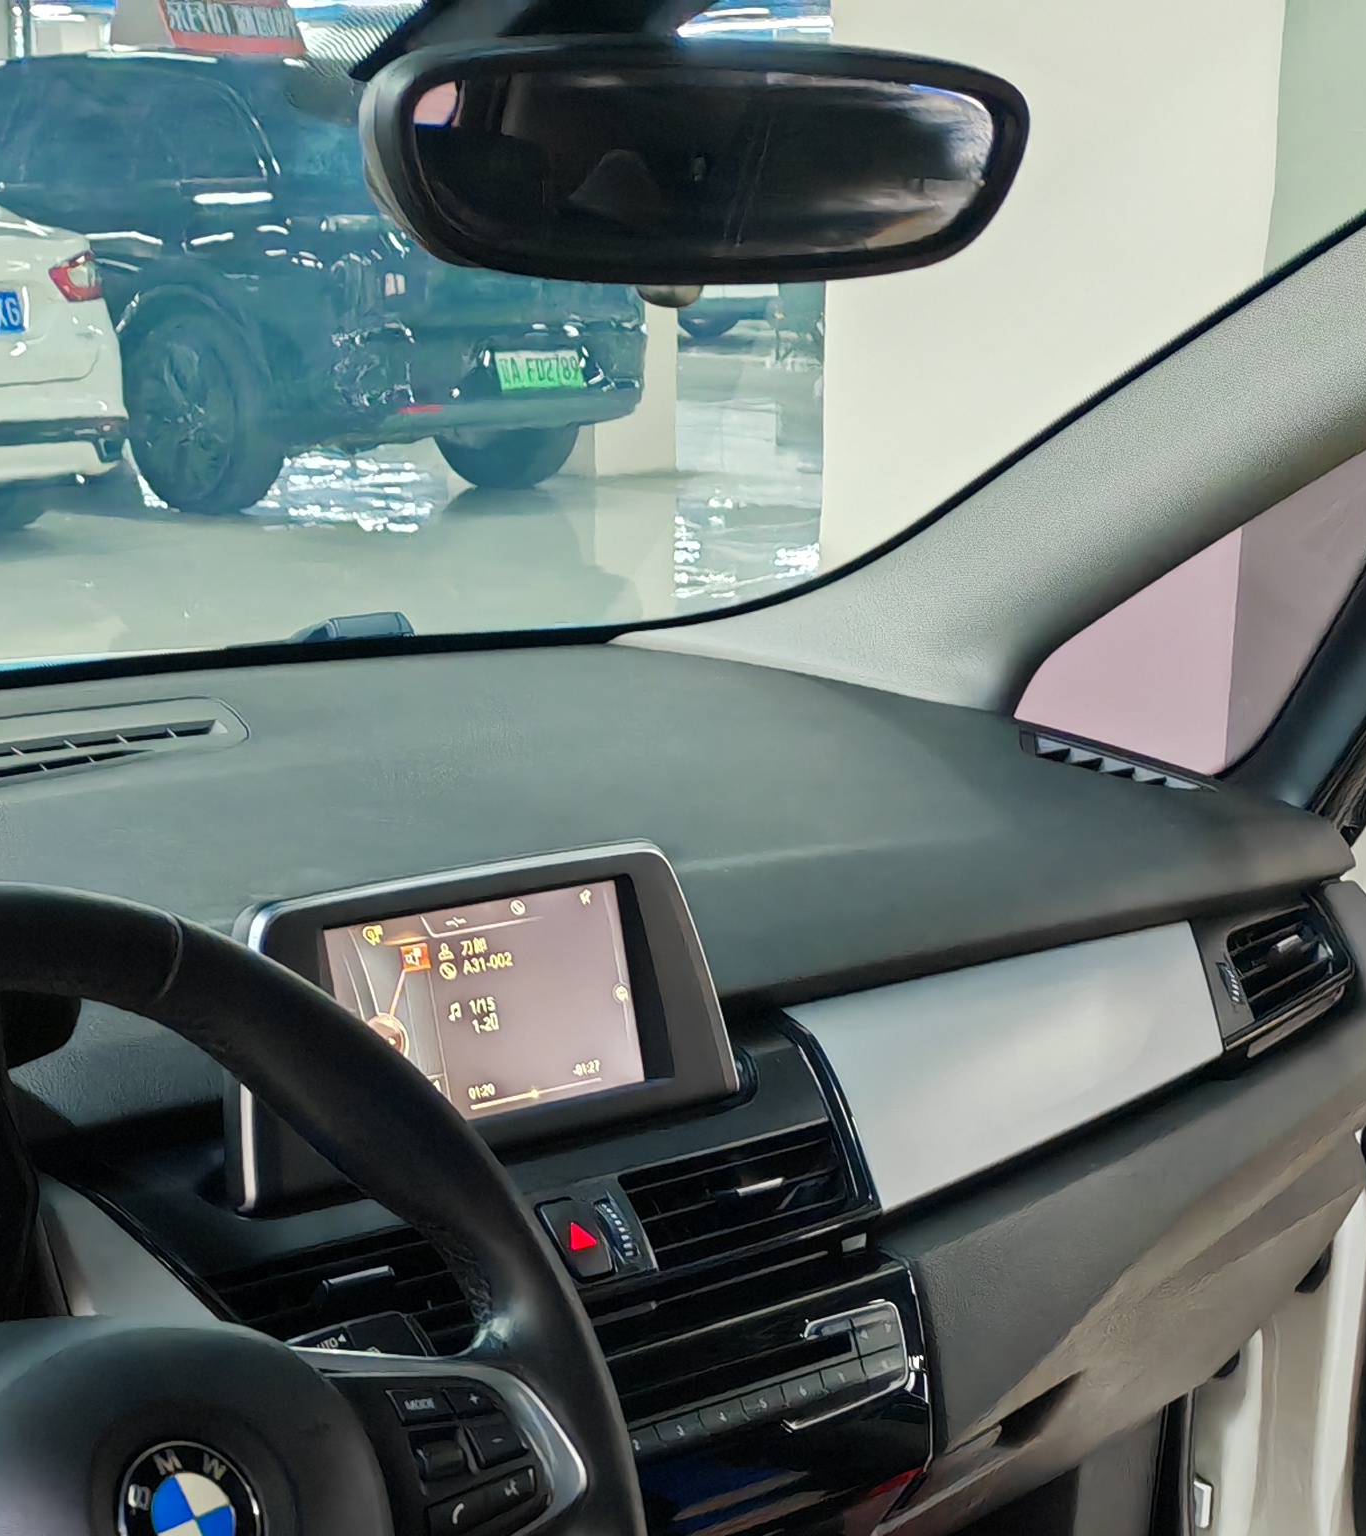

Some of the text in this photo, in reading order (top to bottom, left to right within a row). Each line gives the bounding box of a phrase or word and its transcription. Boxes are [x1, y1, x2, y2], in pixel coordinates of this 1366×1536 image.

[463, 952, 514, 975] A31-002
[468, 1082, 496, 1100] 01:20
[128, 1449, 228, 1511] BMW
